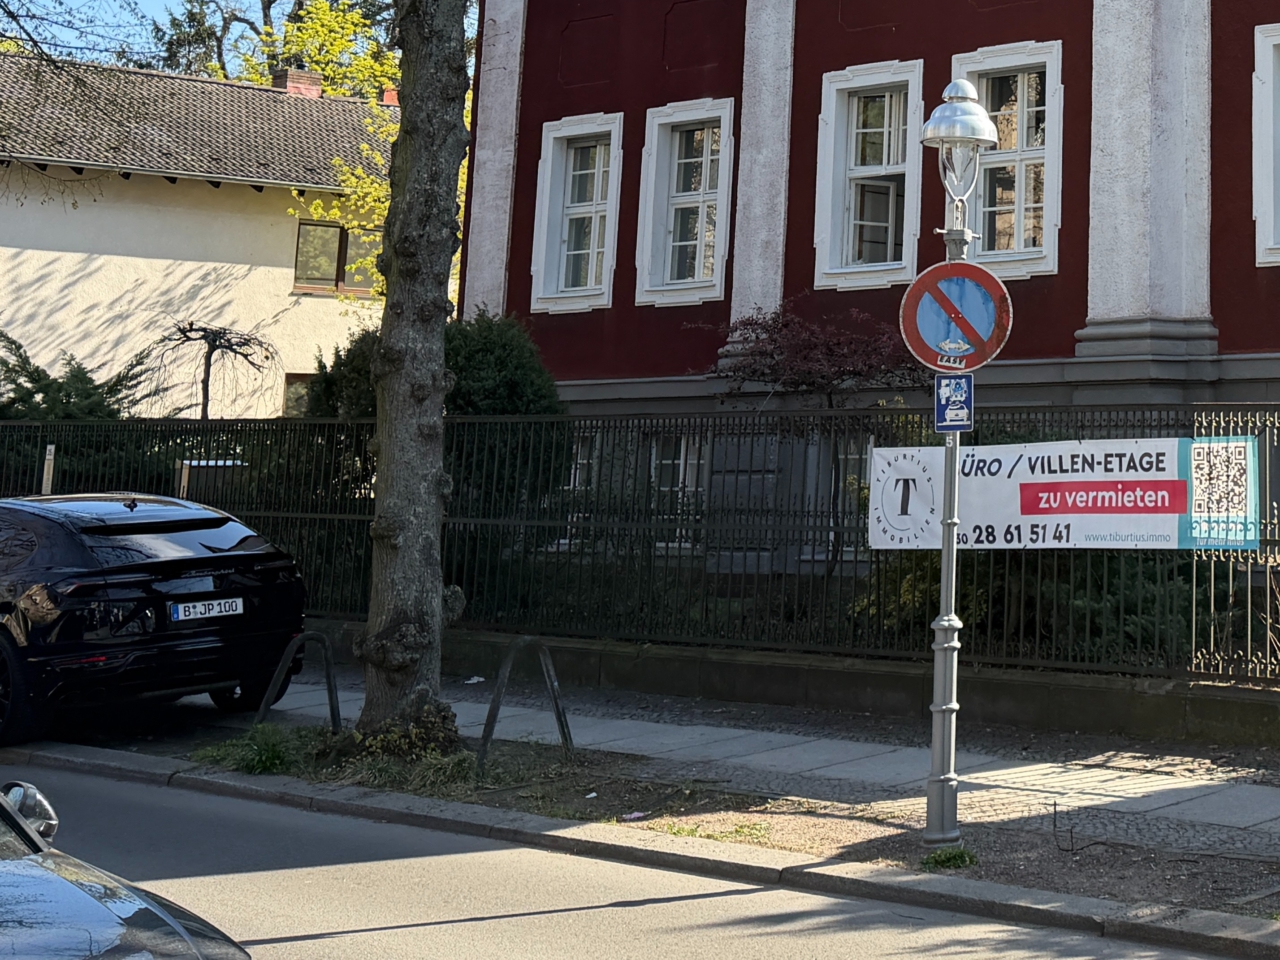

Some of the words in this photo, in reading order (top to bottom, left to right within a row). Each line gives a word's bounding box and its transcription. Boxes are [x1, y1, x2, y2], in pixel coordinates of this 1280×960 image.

[939, 356, 965, 367] EASY
[946, 436, 954, 447] 5
[876, 453, 933, 483] TIBURTIUS
[959, 453, 1003, 477] ÜRO
[1028, 452, 1167, 475] VILLEN-ETAGE
[893, 478, 918, 516] T
[1039, 490, 1062, 509] zu
[1065, 483, 1170, 508] vermieten
[874, 506, 935, 544] IMMOBILIEN
[956, 532, 969, 545] 30
[972, 524, 997, 545] 28
[1003, 524, 1023, 544] 61
[1029, 523, 1048, 543] 51
[1052, 522, 1072, 543] 41
[1084, 531, 1171, 543] www.tiburtius.immo
[183, 605, 192, 618] B
[199, 603, 214, 616] JP
[218, 601, 238, 614] 100
